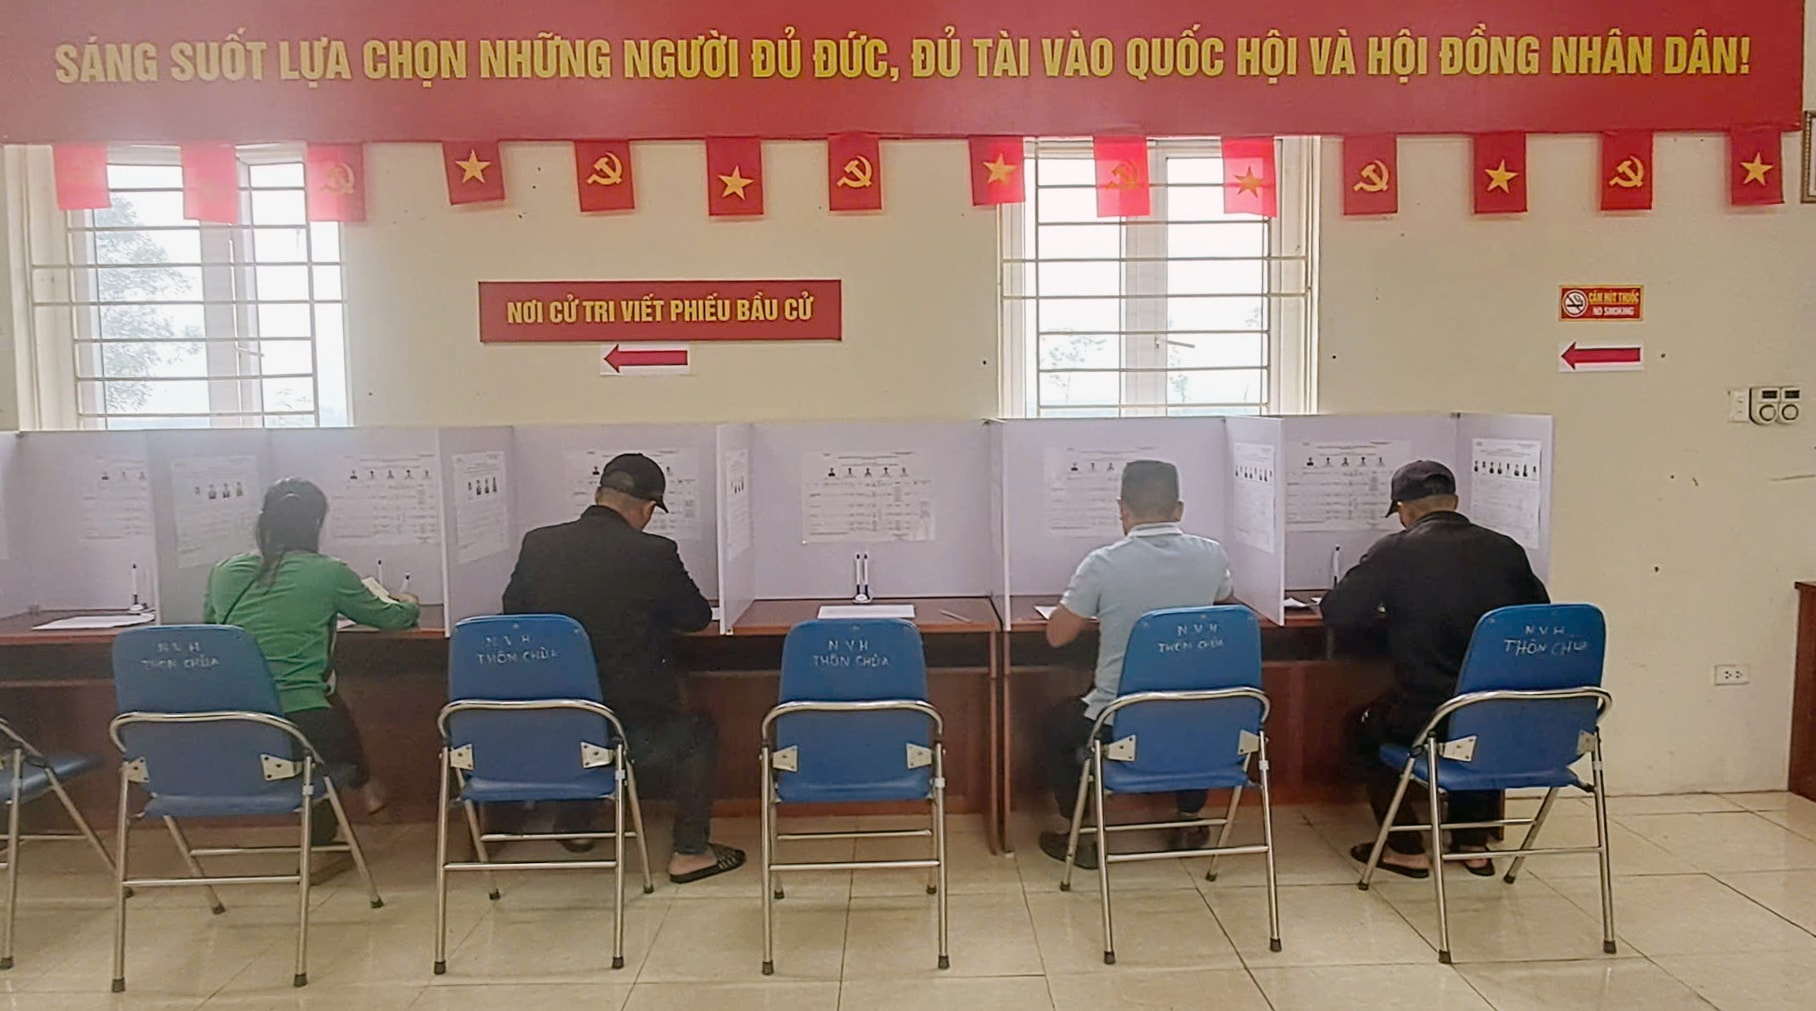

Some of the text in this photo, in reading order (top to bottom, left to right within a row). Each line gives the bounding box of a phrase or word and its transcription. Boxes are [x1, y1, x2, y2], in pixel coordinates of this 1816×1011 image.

[54, 23, 1752, 89] SÁNG SUỐT LỰA CHỌN NHỮNG NGƯỜI ĐỦ ĐỨC, ĐỦ TÀI VÀO QUỐC HỘI VÀ HỘI ĐỒNG NHÂN DÂN!
[506, 291, 815, 324] NƠI CỬ TRI VIẾT PHIẾU BẦU CỬ
